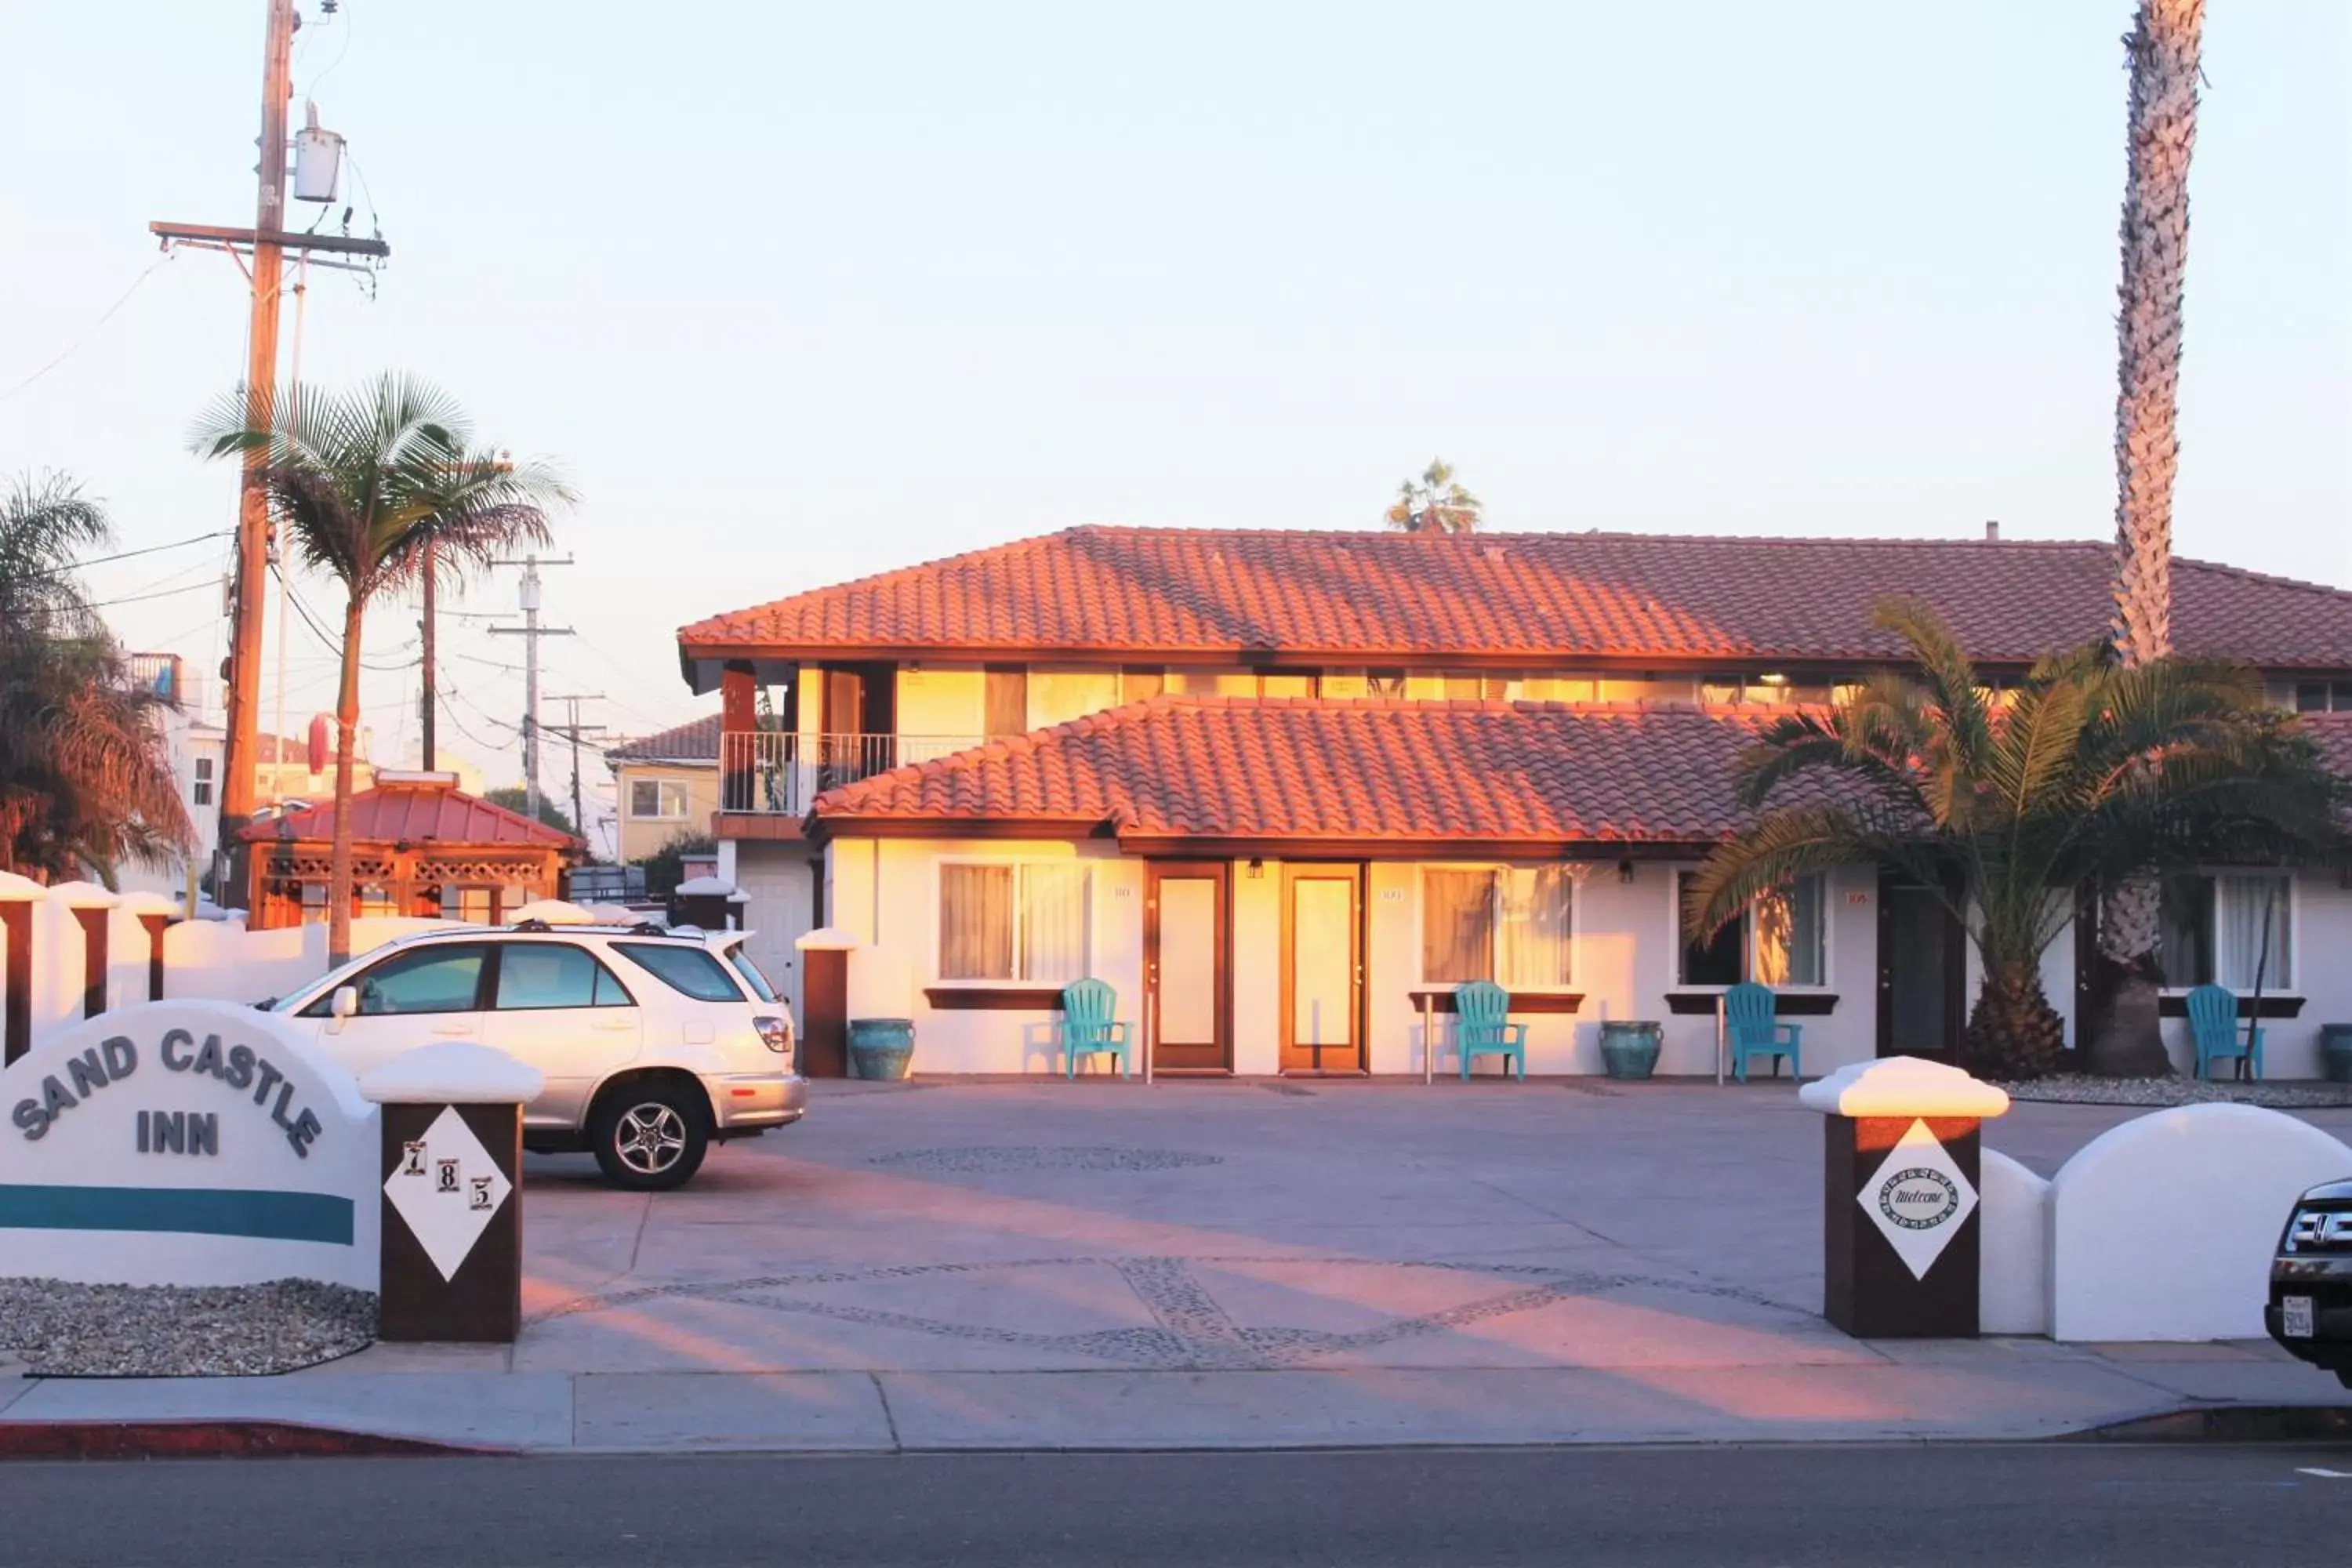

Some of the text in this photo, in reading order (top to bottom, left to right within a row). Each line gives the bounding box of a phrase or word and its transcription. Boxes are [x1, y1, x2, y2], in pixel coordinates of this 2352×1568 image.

[12, 1028, 322, 1159] SAND CASTLE
[136, 1110, 219, 1156] INN
[1895, 1189, 1944, 1203] Welcome
